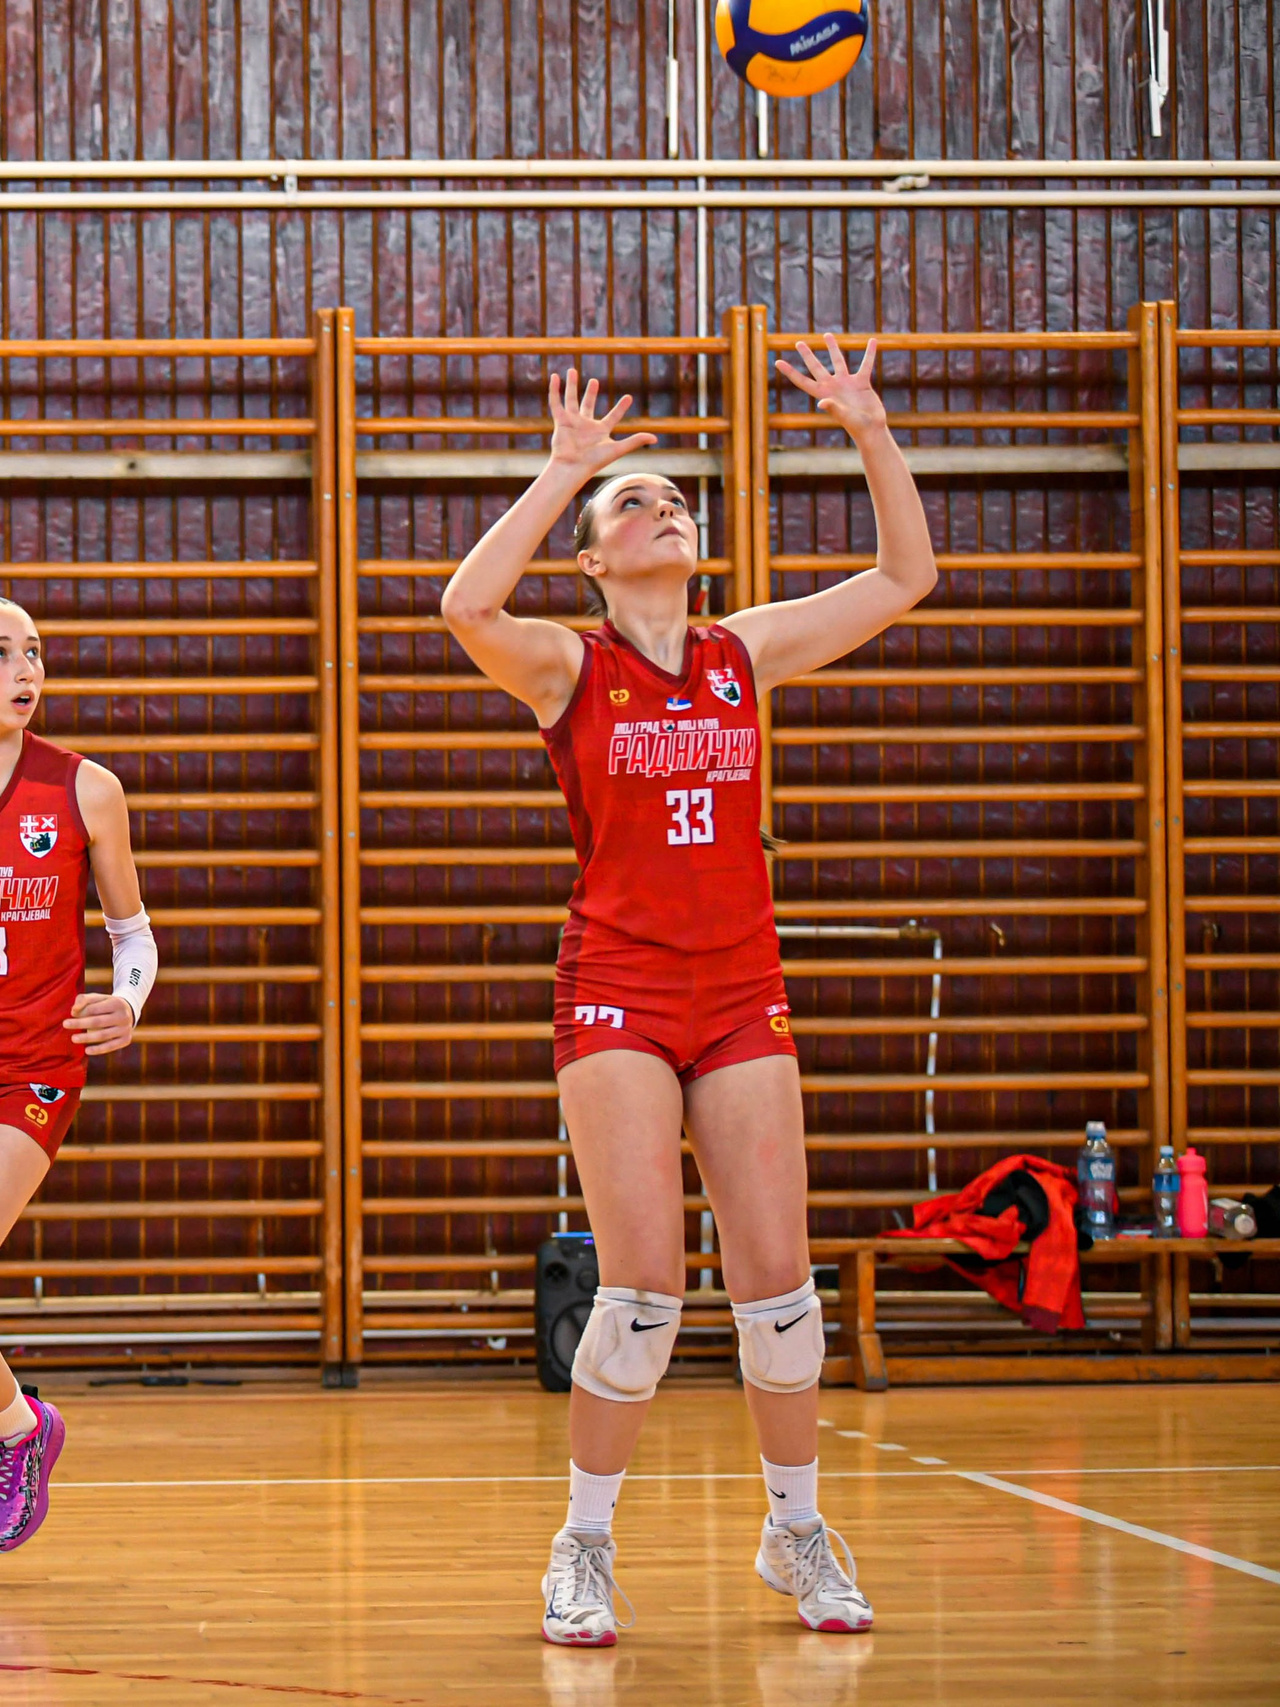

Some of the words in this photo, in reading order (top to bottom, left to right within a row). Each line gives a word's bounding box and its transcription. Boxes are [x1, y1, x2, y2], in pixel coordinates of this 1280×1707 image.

[634, 721, 660, 734] ГРАД
[608, 728, 756, 778] РАДНИЧКИ
[665, 787, 715, 846] 33
[0, 908, 51, 922] КРАГУЈЕВАЦ
